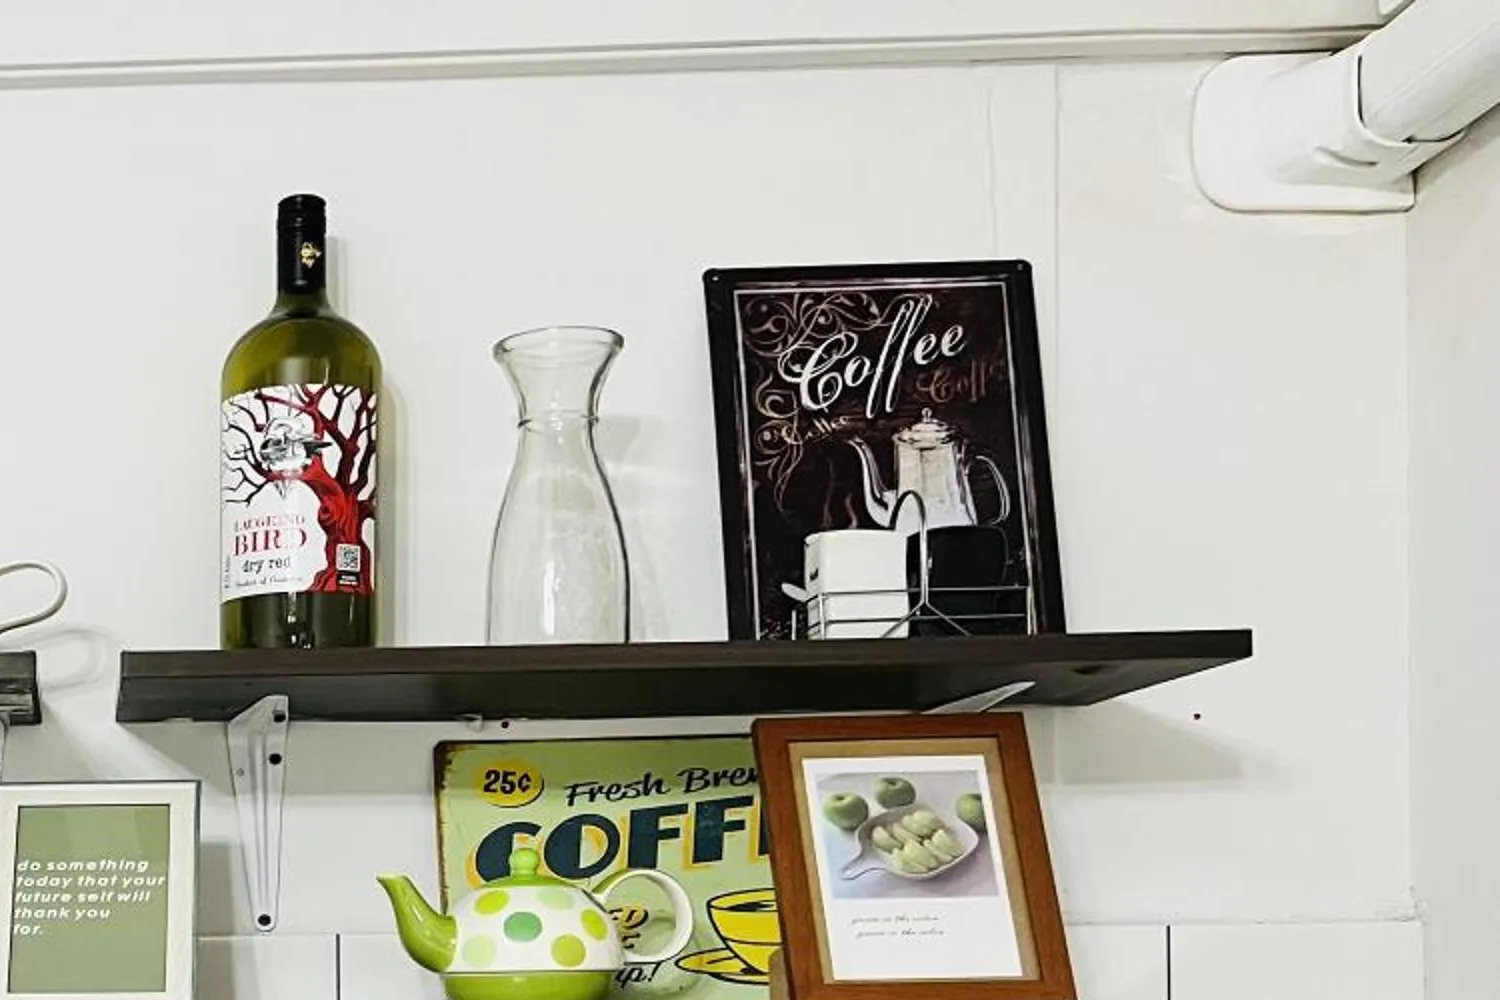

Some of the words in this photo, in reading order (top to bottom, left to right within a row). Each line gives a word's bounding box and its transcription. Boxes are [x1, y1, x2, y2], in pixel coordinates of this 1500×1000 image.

[777, 293, 966, 419] Coffee
[233, 528, 308, 556] BIRD
[243, 559, 265, 574] dry
[483, 769, 532, 794] 25¢
[565, 773, 671, 807] Fresh
[475, 796, 770, 882] COFF
[17, 860, 41, 871] do
[47, 859, 149, 873] something
[16, 875, 73, 889] today
[77, 875, 118, 887] that
[122, 875, 166, 889] your
[14, 890, 72, 903] future
[77, 890, 115, 903] self
[117, 890, 151, 902] will
[13, 906, 69, 919] thank
[75, 907, 111, 921] you
[13, 923, 44, 936] for.
